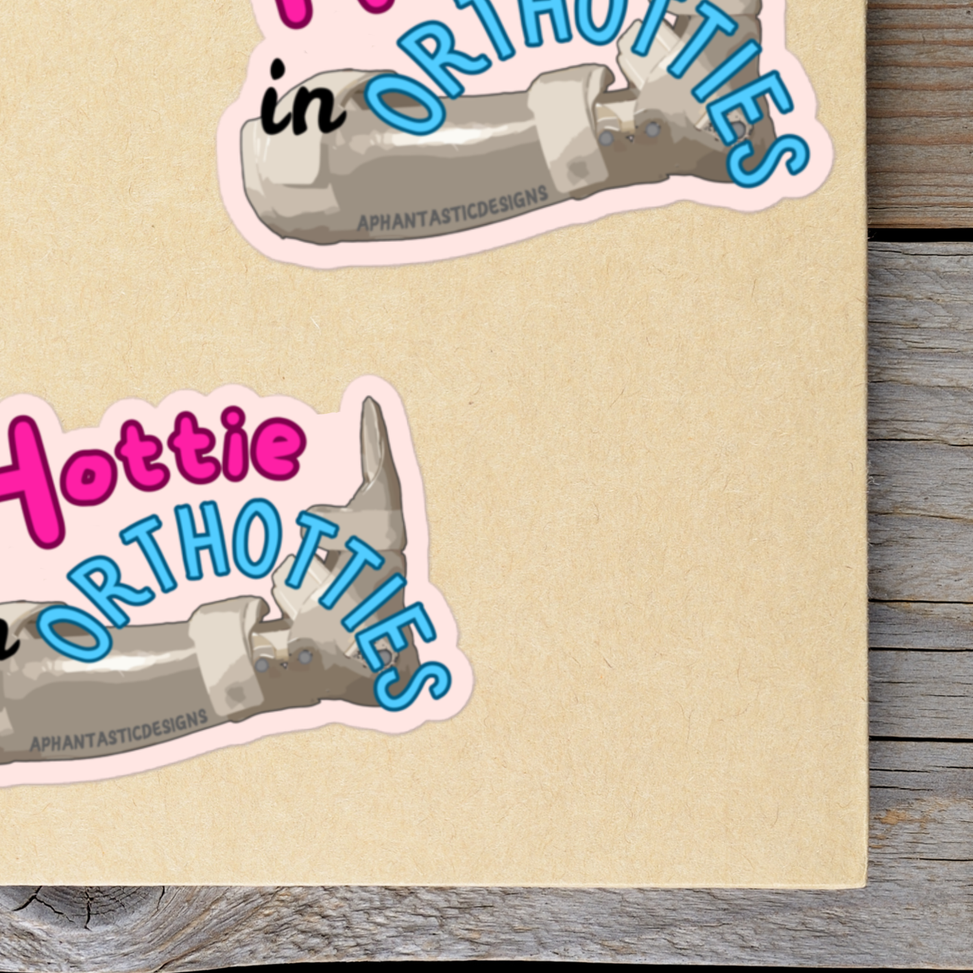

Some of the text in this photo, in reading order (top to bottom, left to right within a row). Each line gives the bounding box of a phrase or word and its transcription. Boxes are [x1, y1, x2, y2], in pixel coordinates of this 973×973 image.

[260, 58, 347, 136] in
[357, 184, 549, 233] APHANTASTICDESIGNS
[35, 497, 452, 712] ORTHOTTIES
[29, 708, 209, 754] APHANTASTICDESIGNS
